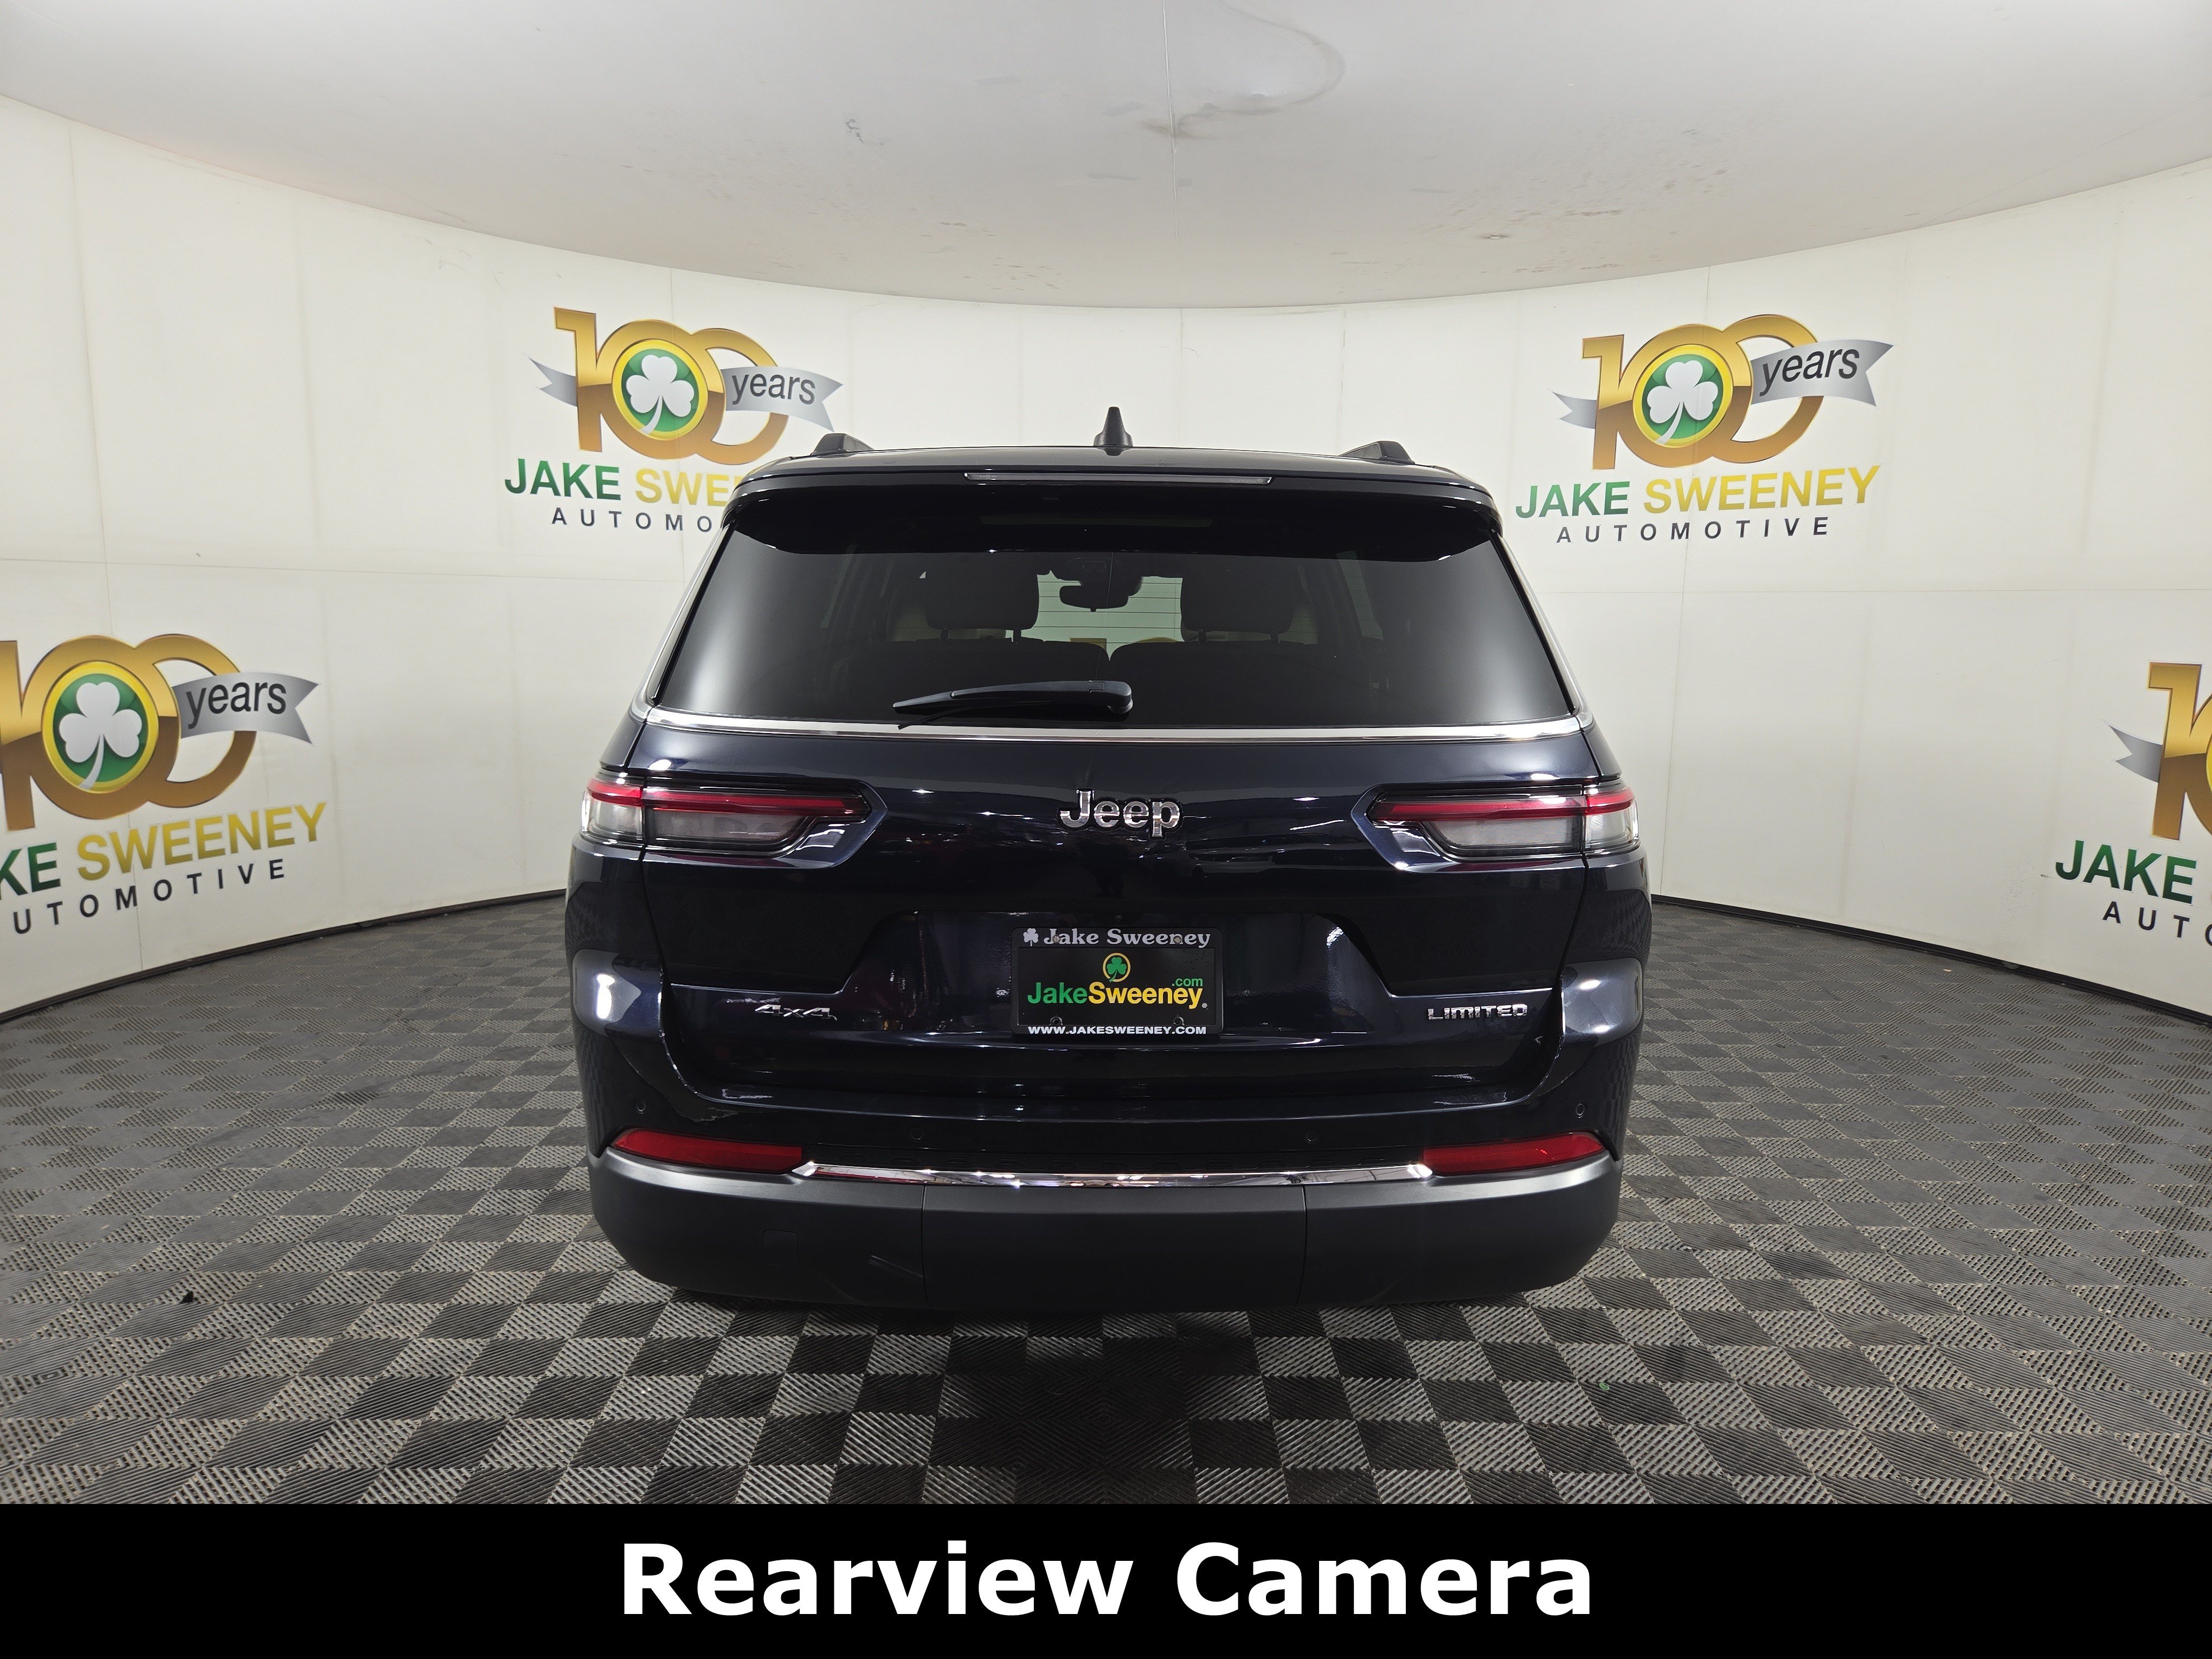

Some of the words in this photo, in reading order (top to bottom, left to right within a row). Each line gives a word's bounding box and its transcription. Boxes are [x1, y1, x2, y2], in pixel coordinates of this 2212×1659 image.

[554, 306, 788, 465] 100
[731, 370, 816, 405] years
[1581, 314, 1824, 470] 100
[1759, 348, 1860, 397] years
[504, 458, 621, 501] JAKE
[635, 468, 744, 507] SWE
[1515, 481, 1630, 518] JAKE
[1643, 465, 1881, 514] SWEENEY
[1556, 516, 1829, 544] AUTOMOTIVE
[186, 681, 287, 729] years
[1059, 789, 1181, 838] Jeep
[77, 802, 327, 881] SWEENEY
[2055, 839, 2197, 904] JAKE
[13, 859, 285, 934] UTOMOTIVE
[1044, 928, 1099, 944] Jake
[1107, 928, 1211, 948] Sweeney
[1028, 1026, 1206, 1035] WWW.JAKESWEENEY.COM
[1427, 1004, 1528, 1020] LIMITED
